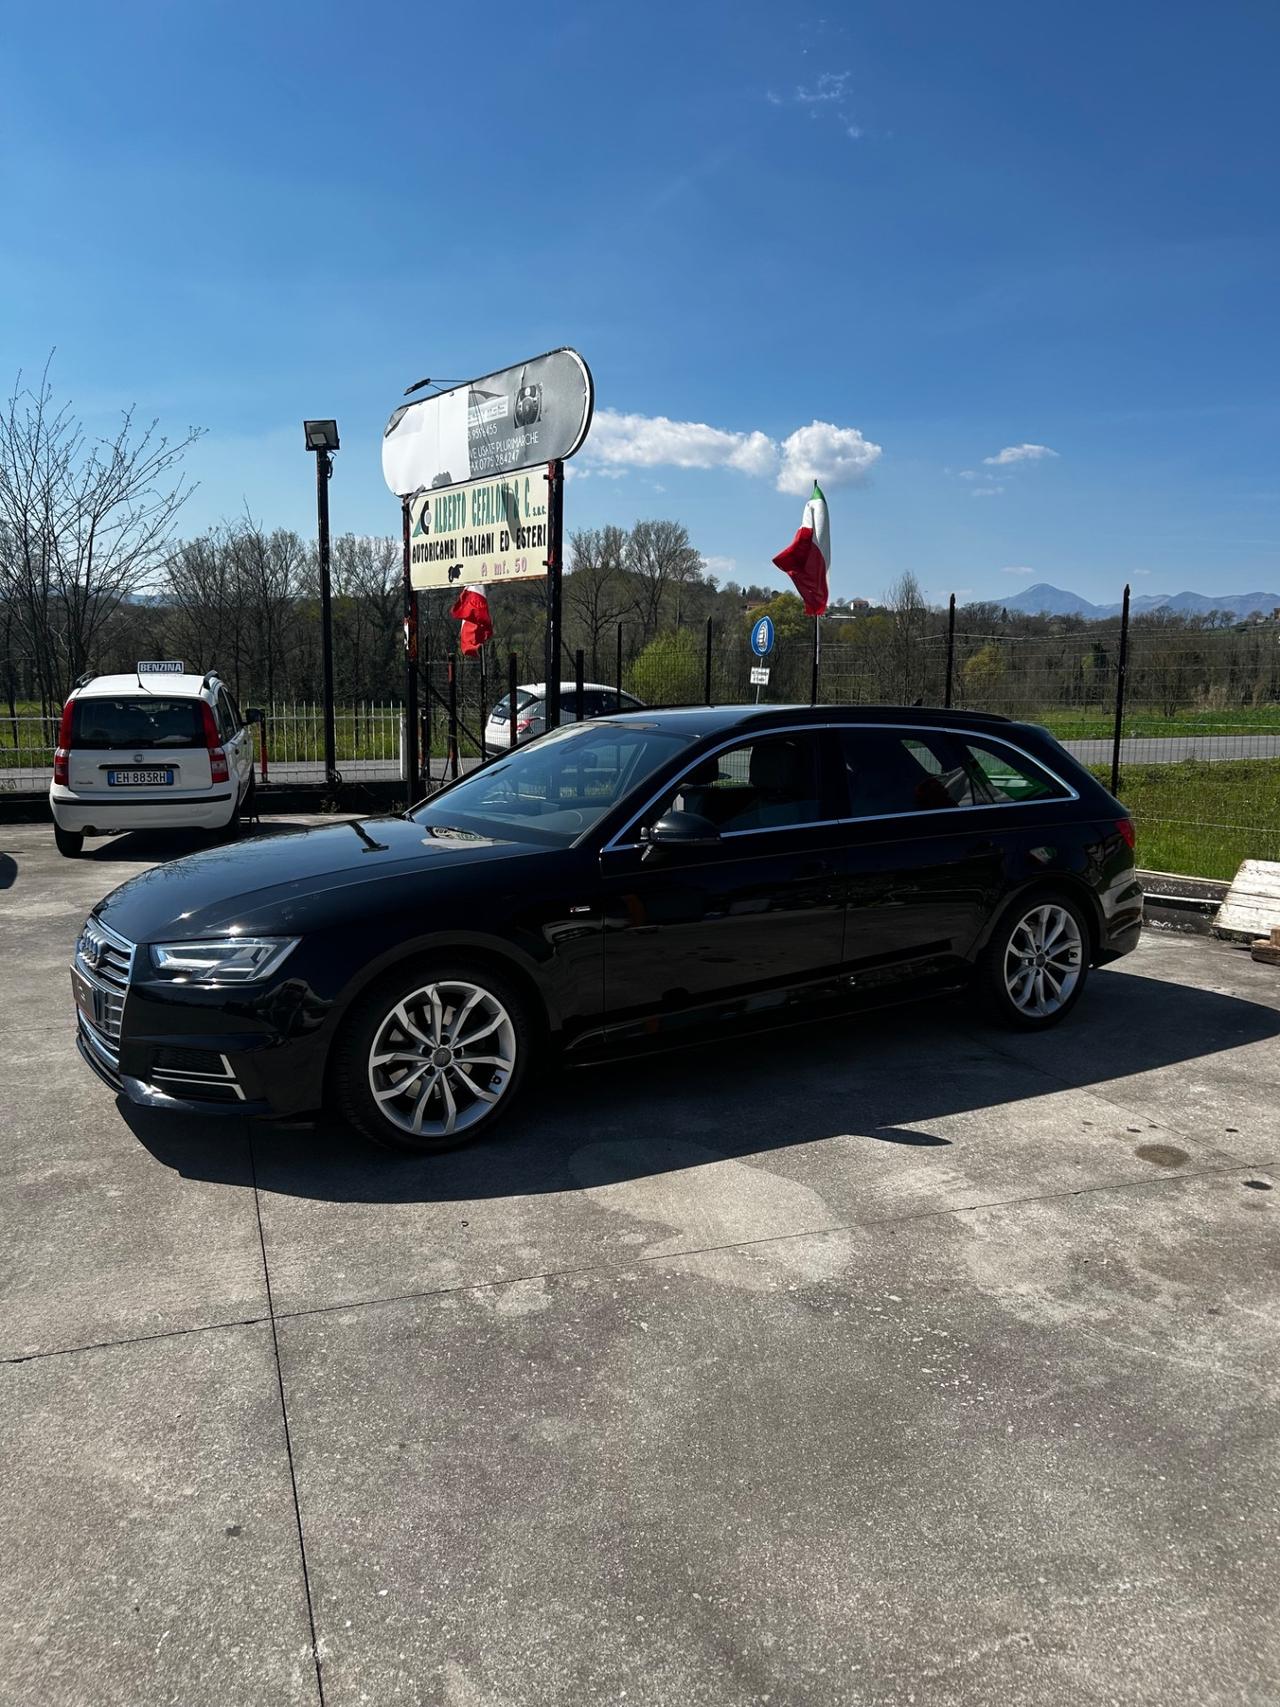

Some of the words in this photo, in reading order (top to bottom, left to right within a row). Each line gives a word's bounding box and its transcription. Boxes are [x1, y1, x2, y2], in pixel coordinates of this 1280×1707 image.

[496, 431, 539, 453] PLURIMARCHE
[495, 449, 520, 467] 284247
[434, 490, 467, 534] ALBERTO
[412, 538, 457, 564] AUTORICAMBI
[462, 532, 494, 557] ITALIANI
[499, 529, 510, 552] ED
[516, 523, 547, 550] ESTERI
[481, 562, 487, 577] A
[515, 556, 527, 574] 50
[140, 663, 182, 672] BENZINA
[116, 772, 130, 783] EH
[132, 772, 166, 783] 883RH
